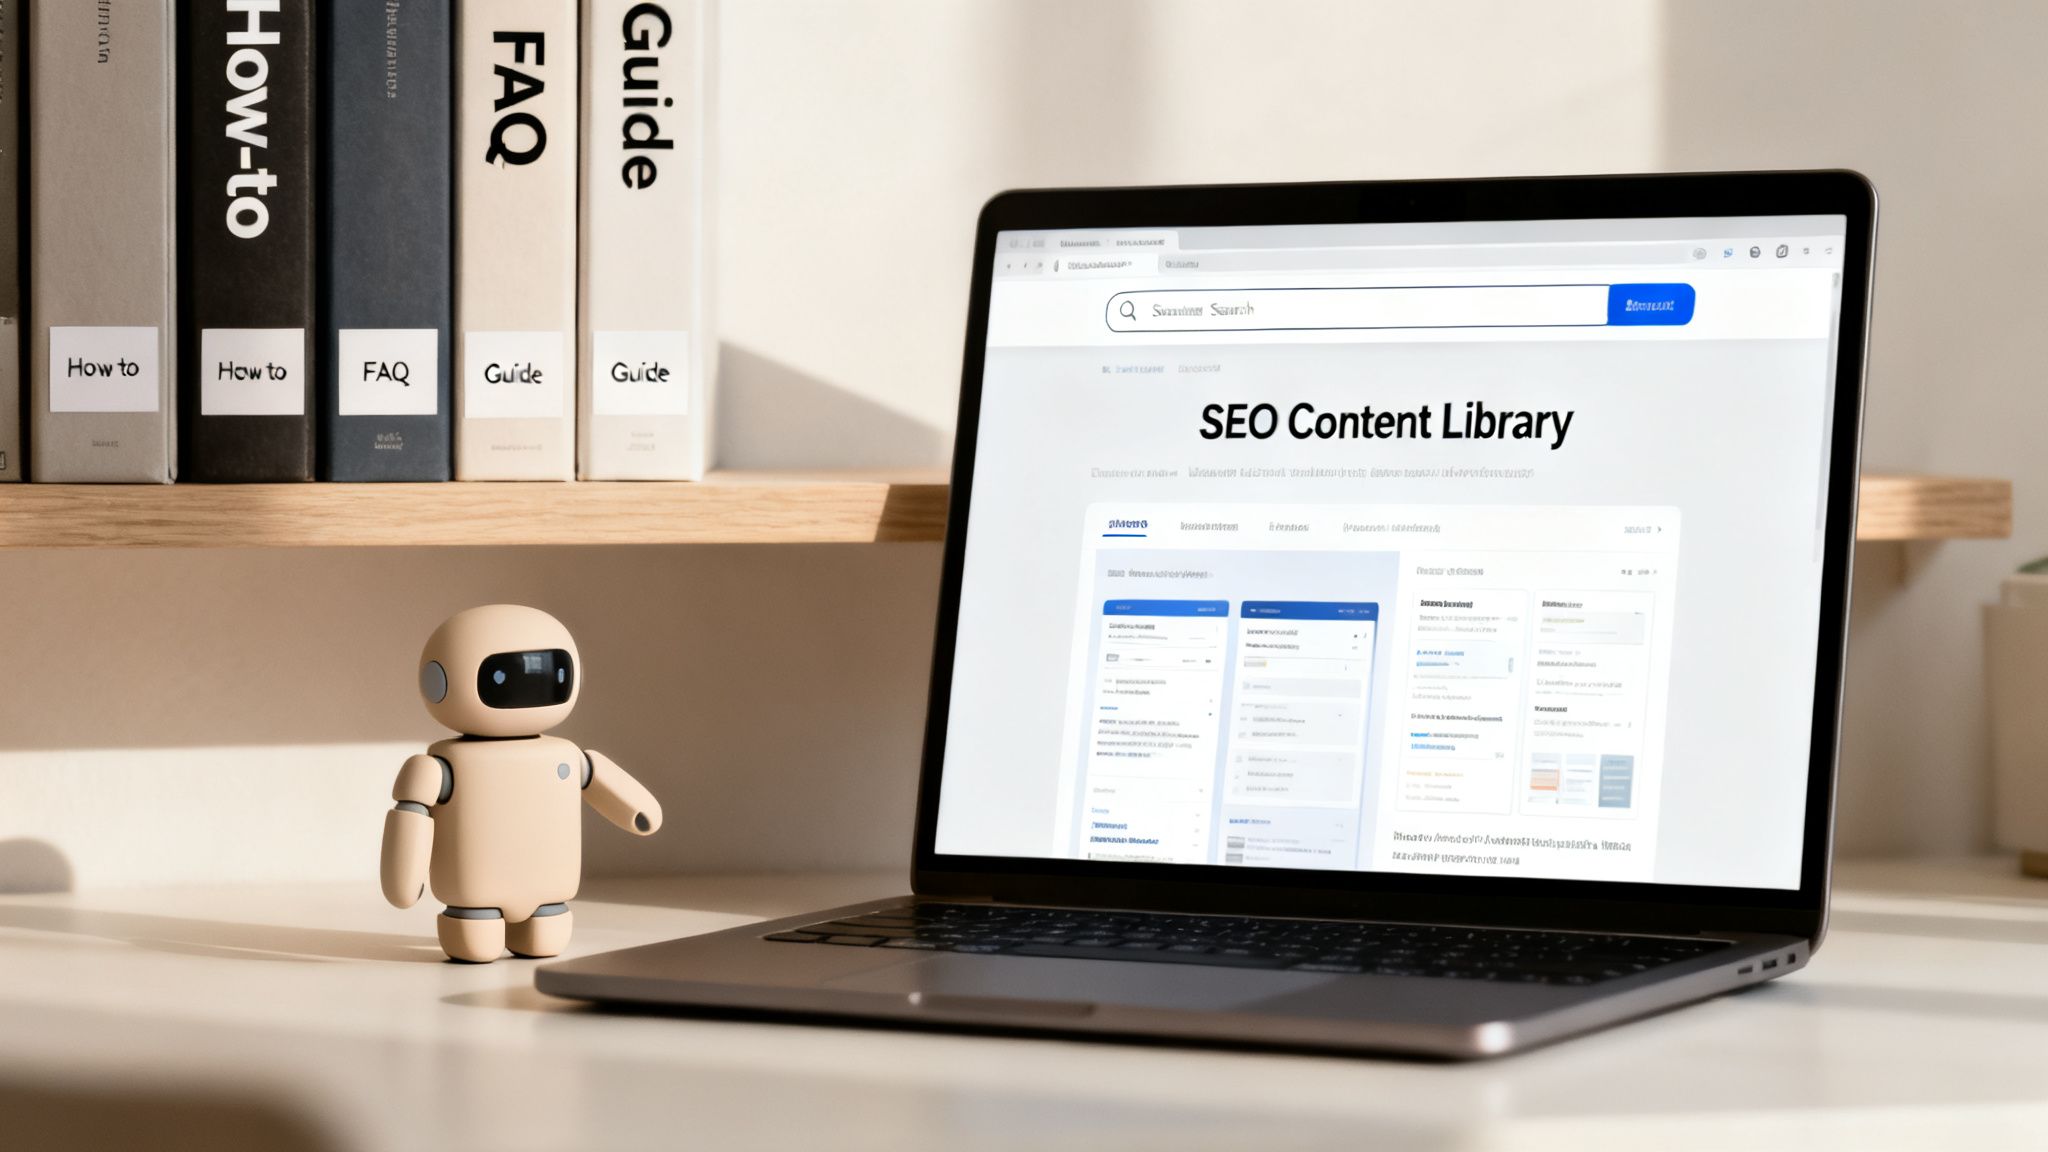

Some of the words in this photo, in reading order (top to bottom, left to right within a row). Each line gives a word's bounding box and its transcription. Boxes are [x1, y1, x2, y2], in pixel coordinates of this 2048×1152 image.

[485, 31, 548, 168] FAQ
[622, 2, 674, 190] Guide
[226, 0, 280, 239] How-to
[68, 357, 113, 378] How
[117, 357, 140, 377] to
[218, 361, 262, 381] How
[266, 362, 288, 381] to
[363, 361, 410, 387] FAQ
[484, 362, 543, 385] Guide
[611, 361, 670, 383] Guide
[1199, 402, 1279, 440] SEO
[1288, 402, 1432, 440] Content
[1442, 400, 1575, 451] Library
